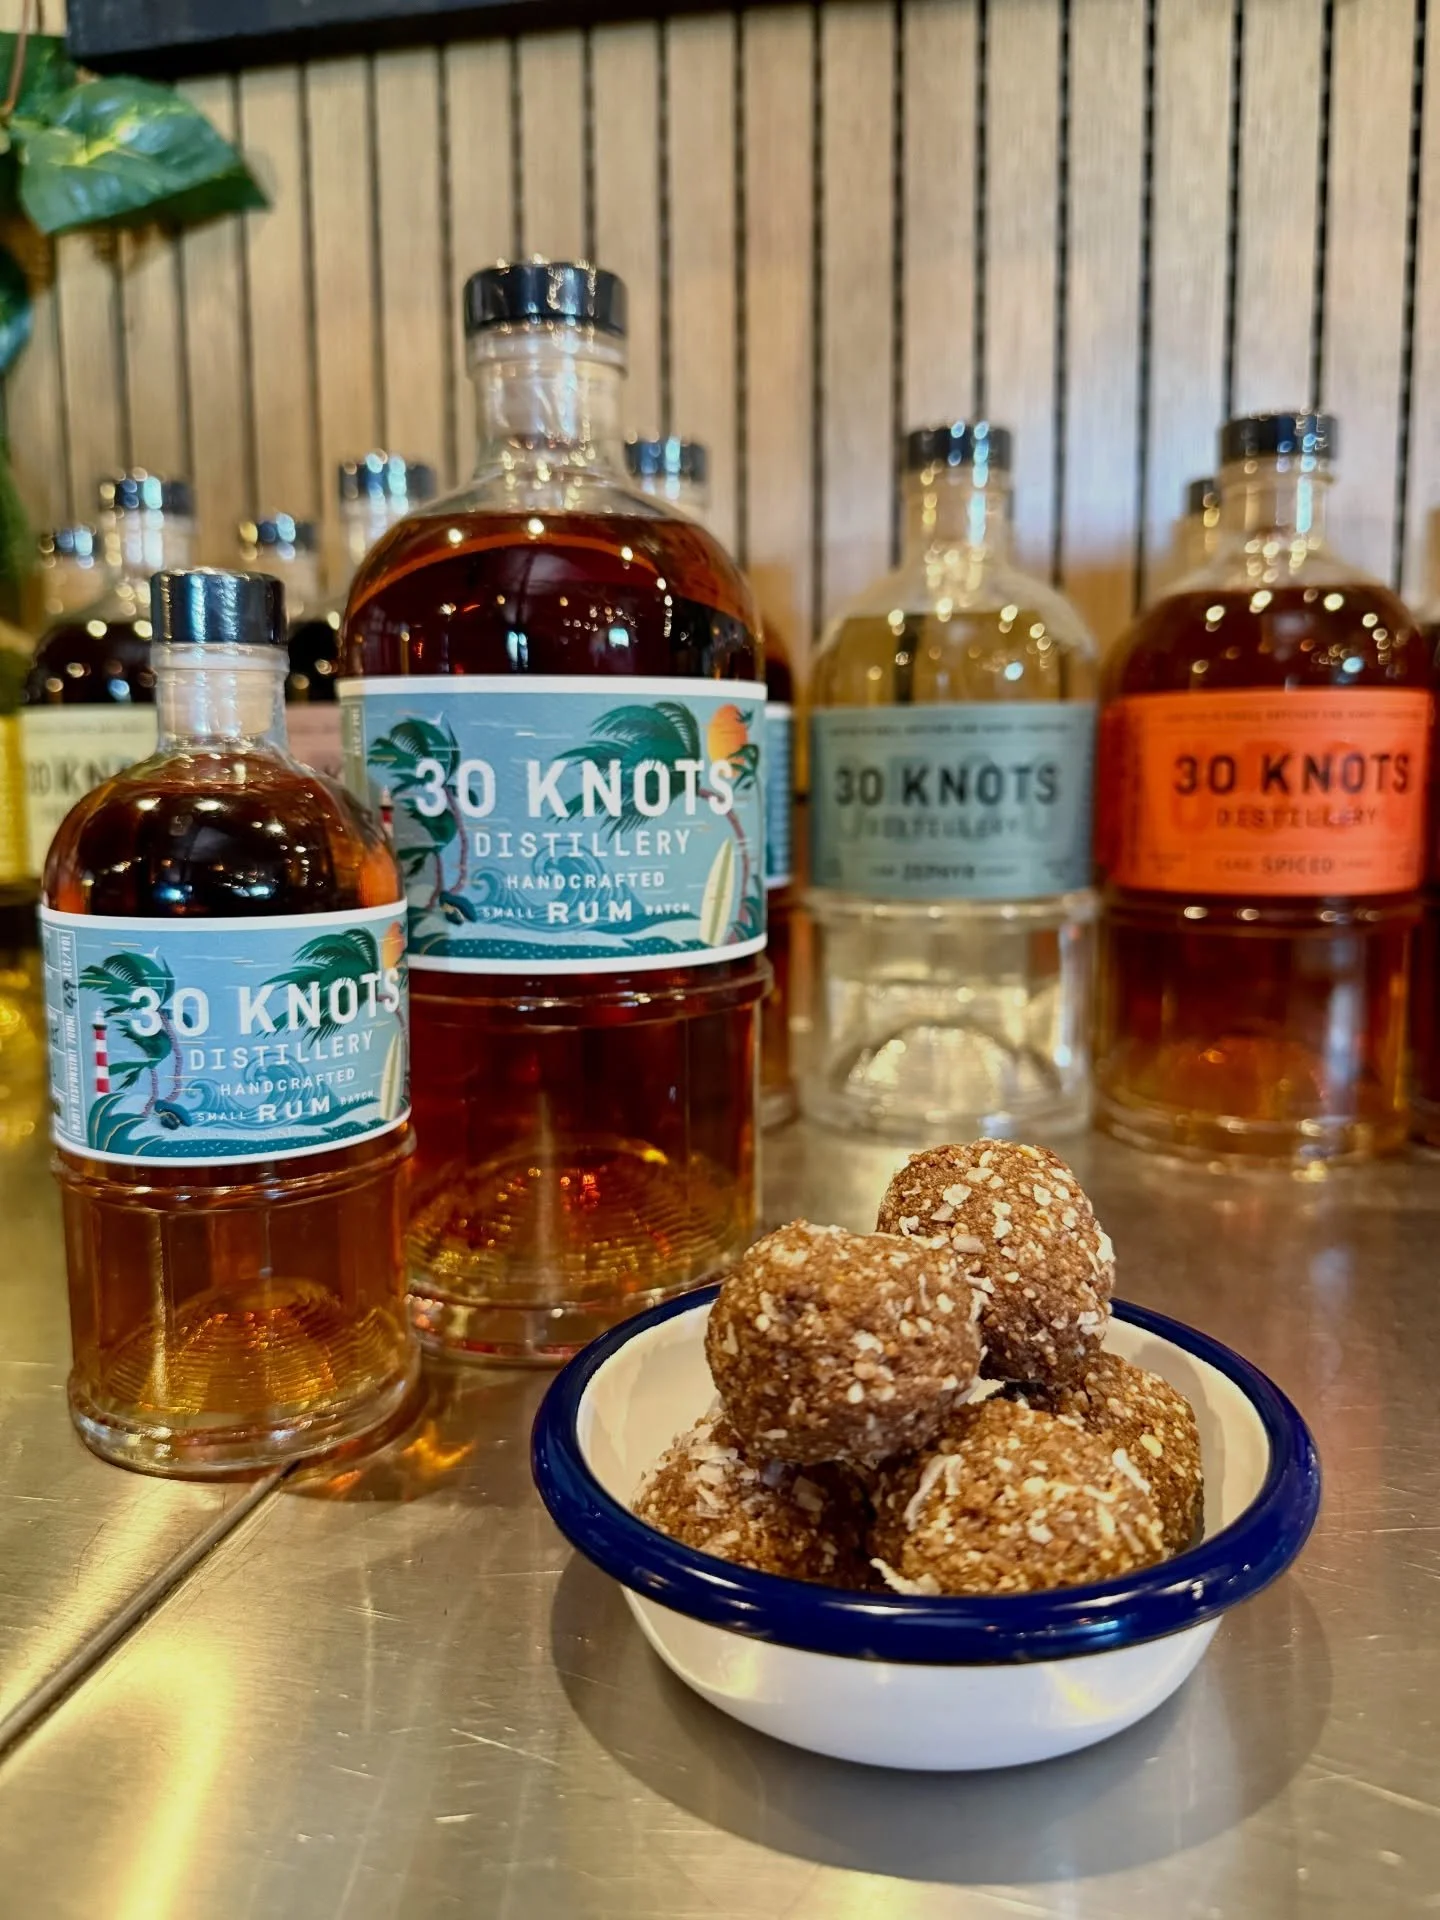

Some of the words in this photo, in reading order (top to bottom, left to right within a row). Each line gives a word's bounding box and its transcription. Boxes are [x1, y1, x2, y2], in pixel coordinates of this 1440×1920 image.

[415, 757, 496, 818] 30
[527, 757, 734, 818] KNOTS
[835, 766, 884, 806] 30
[902, 763, 1061, 806] KNOTS
[1174, 753, 1237, 795] 30
[1261, 751, 1410, 795] KNOTS
[1216, 806, 1377, 829] DISTILLERY
[474, 829, 691, 858] DISTILLERY
[507, 871, 666, 890] HANDCRAFTED
[482, 905, 535, 920] SMALL
[548, 901, 633, 924] RUM
[645, 903, 691, 916] BATCH
[129, 986, 210, 1038] 30
[239, 970, 401, 1036] KNOTS
[190, 1030, 373, 1071] DISTILLERY
[220, 1068, 355, 1096] HANDCRAFTED
[197, 1111, 247, 1123] SMALL
[258, 1095, 331, 1123] RUM
